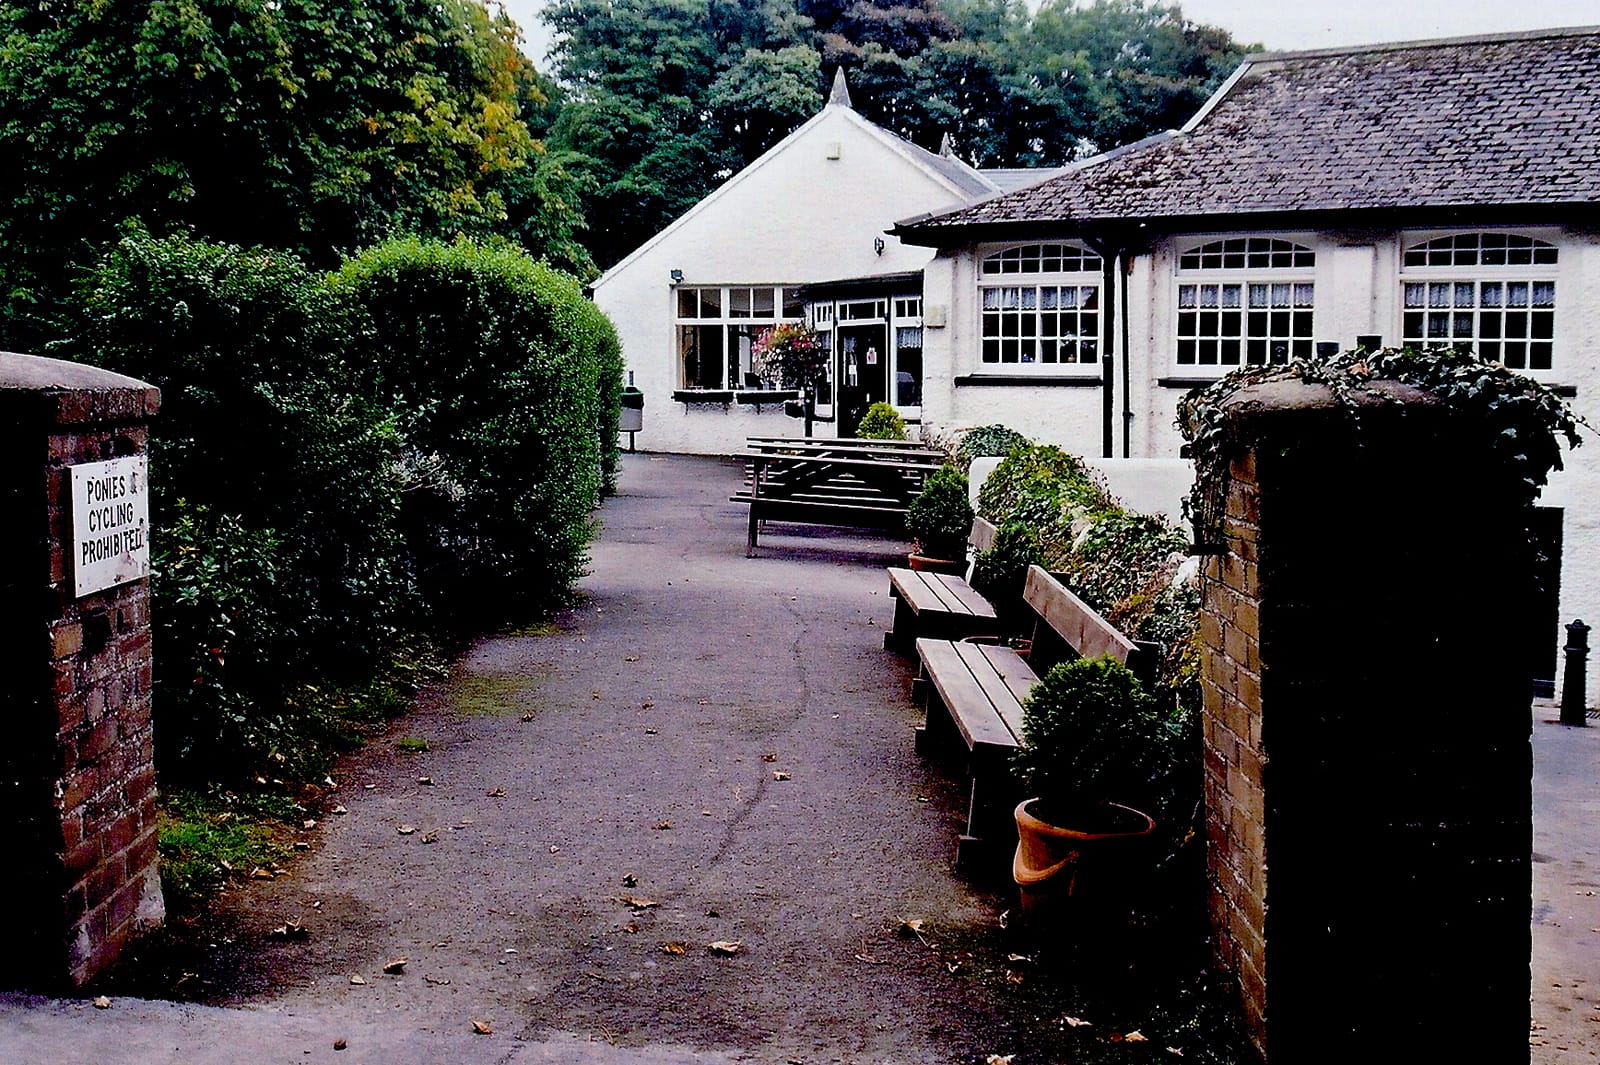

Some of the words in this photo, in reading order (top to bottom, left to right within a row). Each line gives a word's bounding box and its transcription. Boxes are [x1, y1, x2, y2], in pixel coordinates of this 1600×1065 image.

[87, 476, 126, 504] PONIES
[89, 503, 134, 532] CYCLING
[82, 528, 142, 566] PROHIBITED
